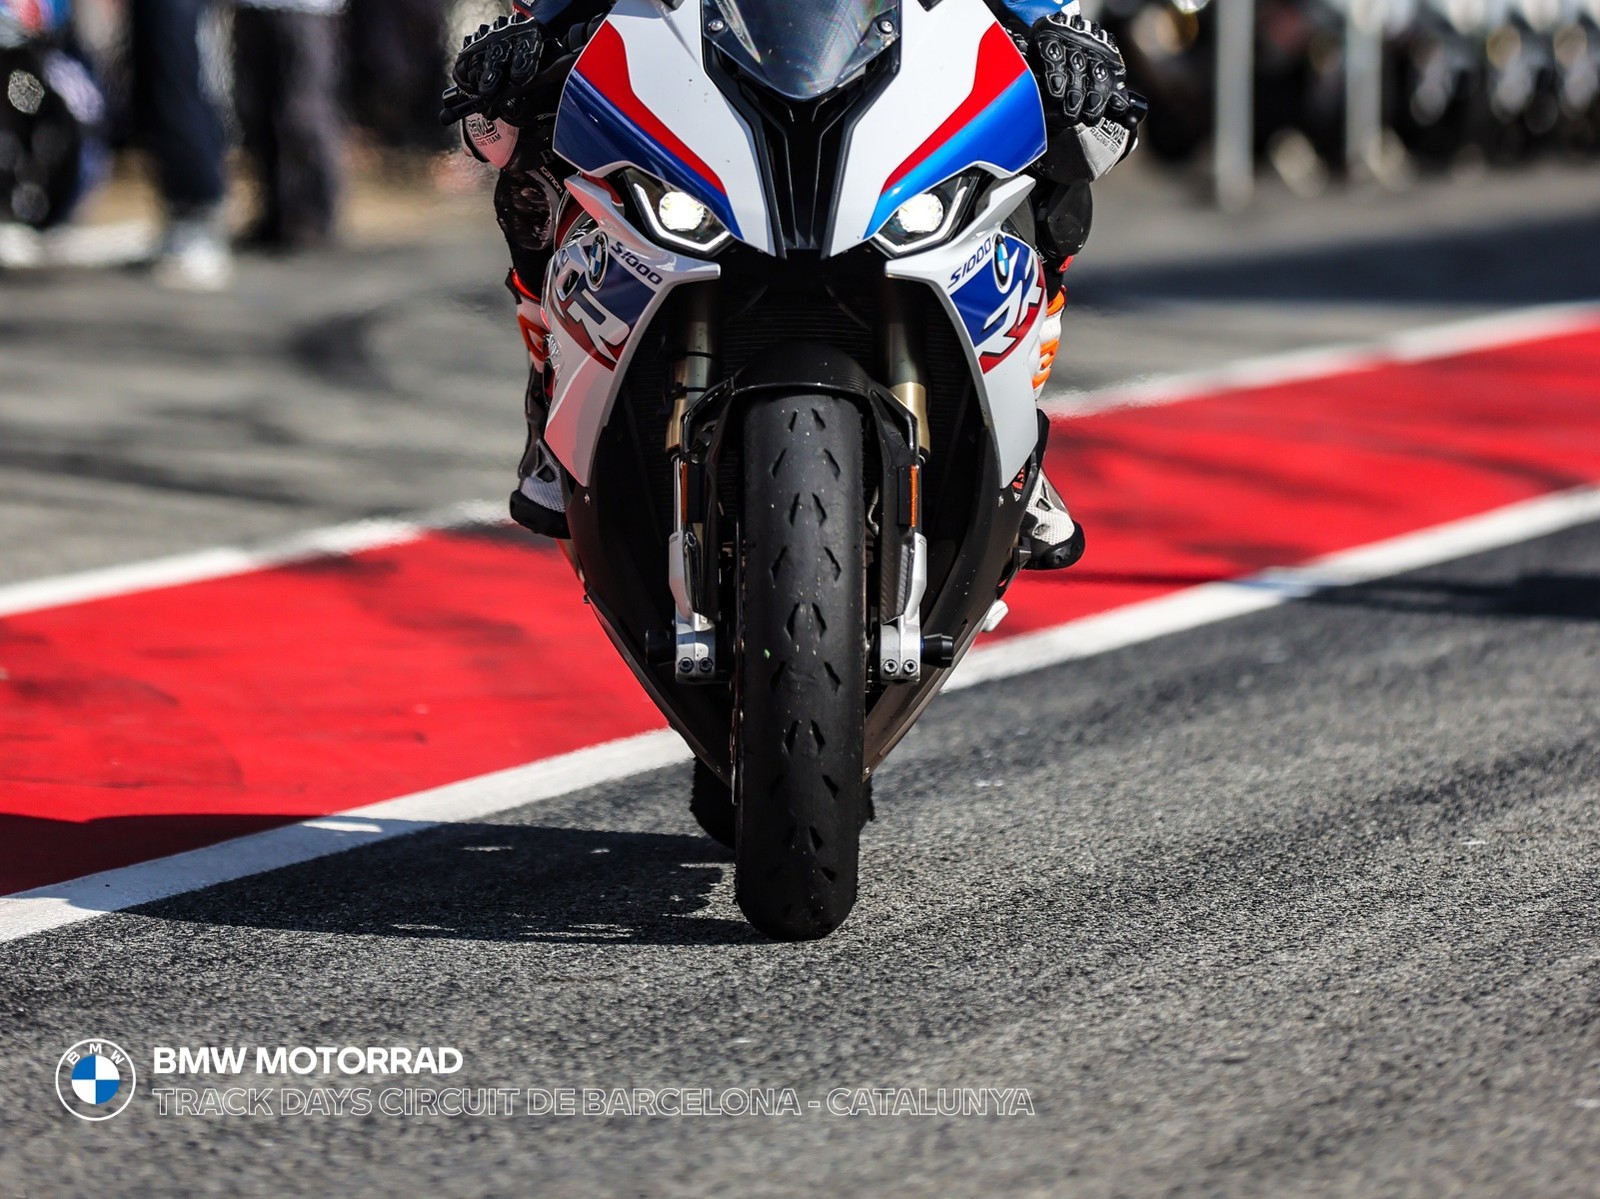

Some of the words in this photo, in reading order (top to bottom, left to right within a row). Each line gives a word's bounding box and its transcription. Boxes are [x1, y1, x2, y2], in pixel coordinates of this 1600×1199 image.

[486, 133, 503, 145] TEAM
[609, 241, 664, 286] S1000
[948, 237, 992, 289] S1000
